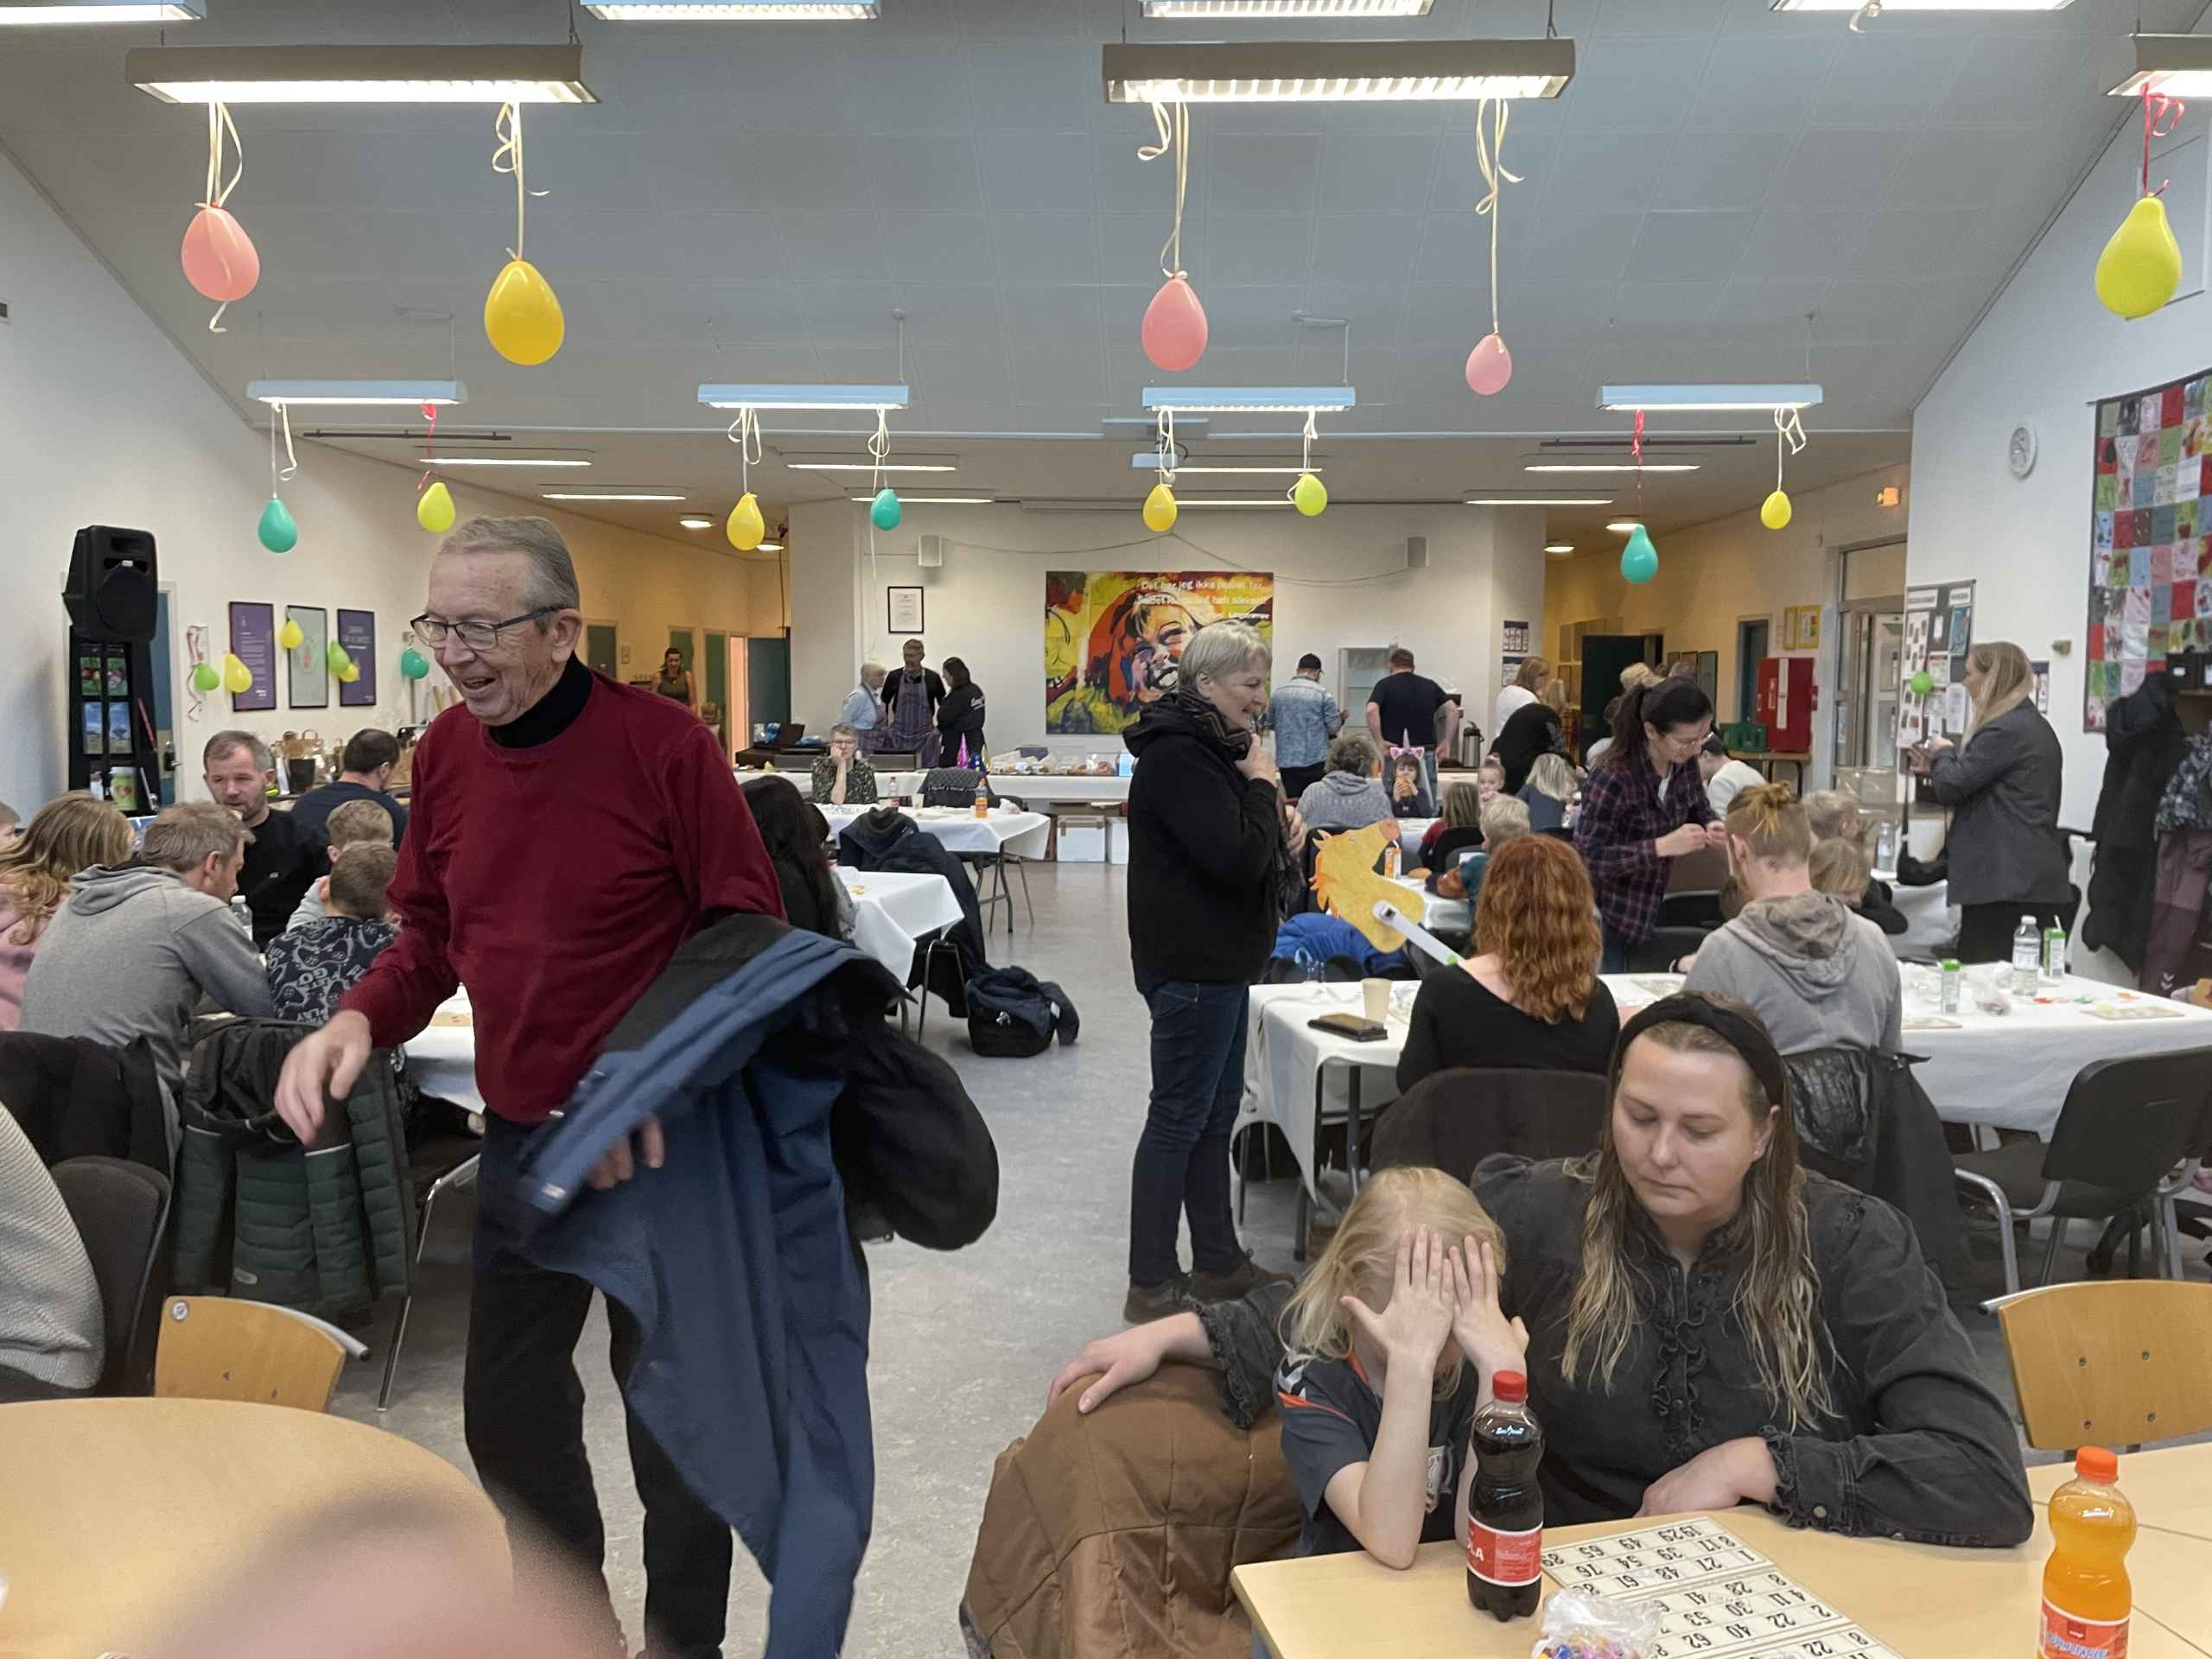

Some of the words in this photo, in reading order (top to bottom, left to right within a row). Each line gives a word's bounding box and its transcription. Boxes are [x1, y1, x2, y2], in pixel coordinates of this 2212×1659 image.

[1658, 1529, 1684, 1541] 29
[1679, 1525, 1702, 1537] 19
[1618, 1537, 1642, 1550] 49
[1698, 1538, 1721, 1552] 17
[1578, 1545, 1605, 1559] 65
[1656, 1547, 1684, 1560] 39
[1616, 1555, 1643, 1569] 54
[1696, 1556, 1723, 1572] 27
[1575, 1562, 1605, 1578] 76
[1615, 1574, 1639, 1588] 61
[1684, 1592, 1707, 1605] 41
[1725, 1600, 1754, 1617] 30
[1811, 1604, 1832, 1618] 2
[1683, 1611, 1712, 1626] 53
[1765, 1612, 1796, 1630] 22
[1726, 1623, 1751, 1639] 40
[1681, 1633, 1712, 1649] 62
[1802, 1640, 1834, 1657] 22
